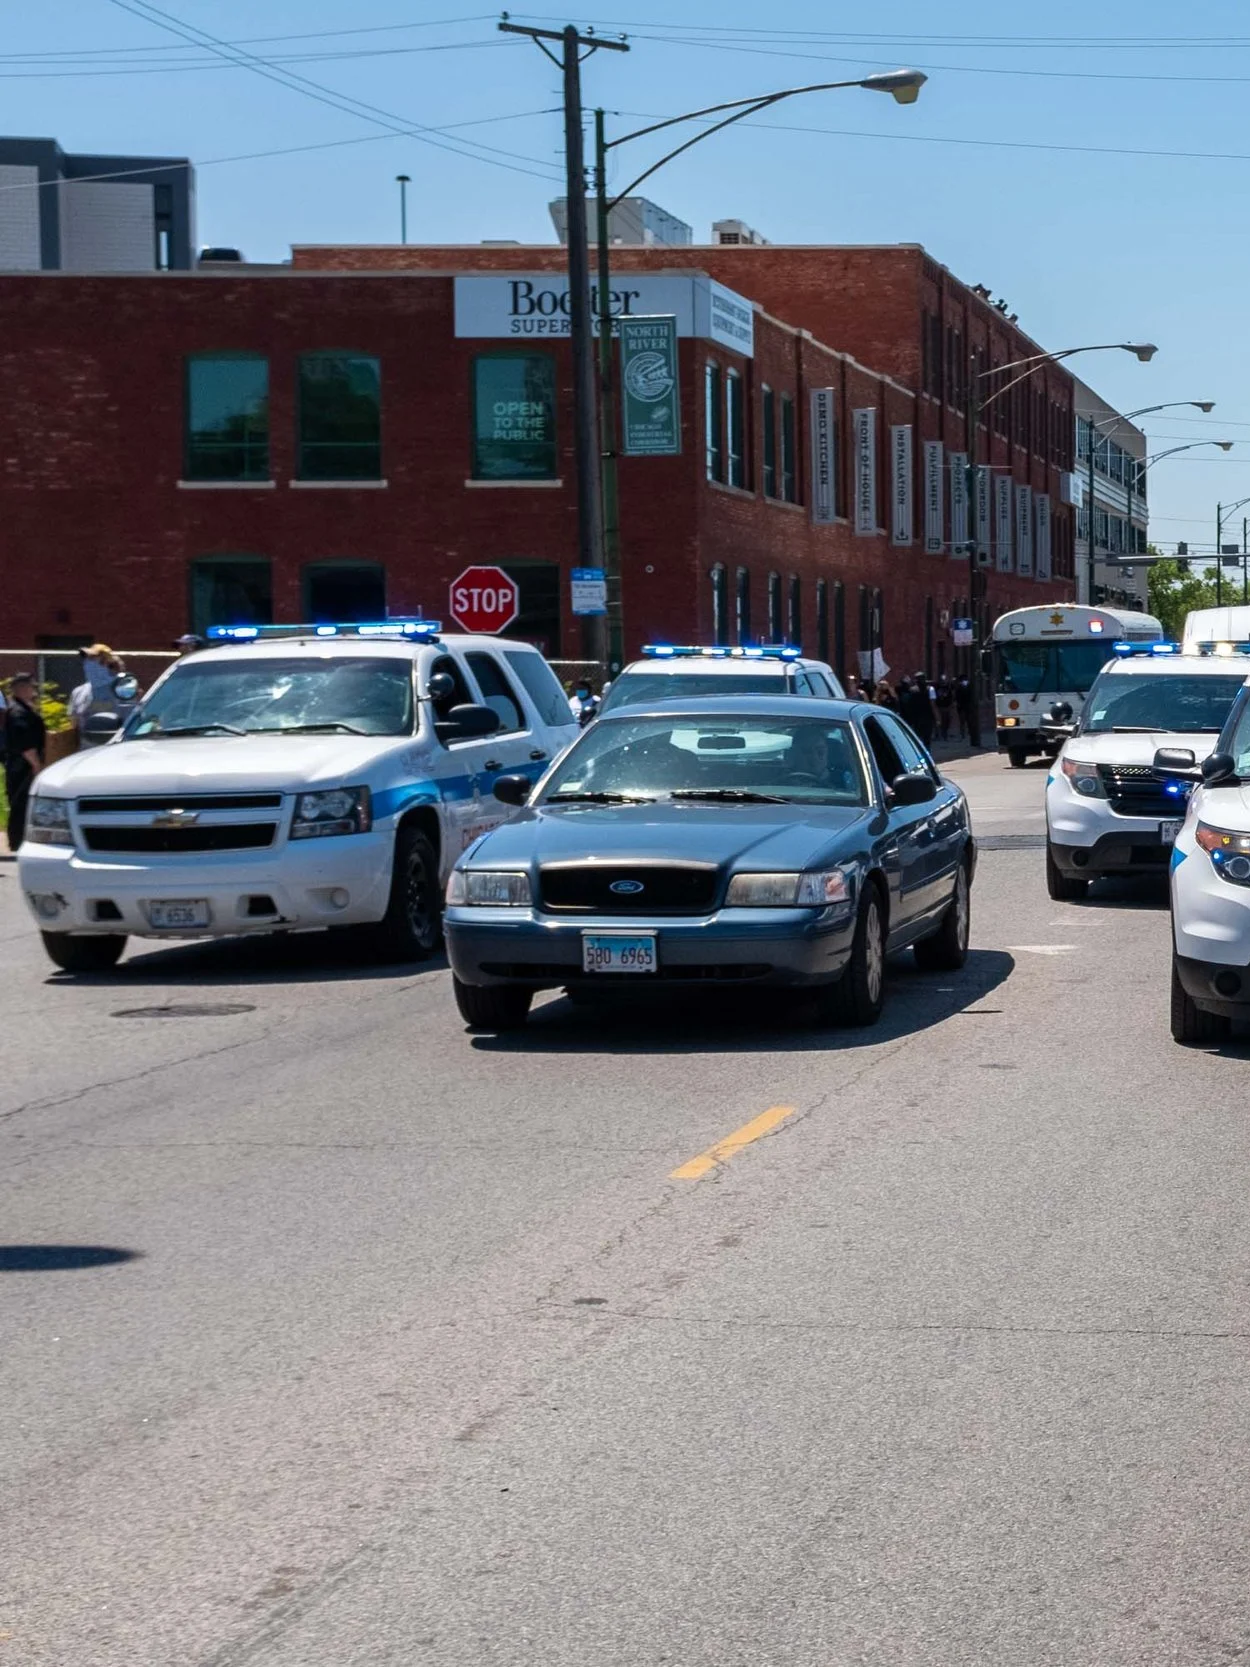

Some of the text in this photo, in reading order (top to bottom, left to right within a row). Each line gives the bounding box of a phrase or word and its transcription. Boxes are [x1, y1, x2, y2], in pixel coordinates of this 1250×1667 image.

[627, 326, 668, 337] NORTH
[629, 338, 667, 349] RIVER
[493, 402, 545, 415] OPEN
[494, 417, 545, 428] TO THE
[493, 429, 545, 440] PUBLIC
[860, 413, 869, 449] FRONT
[817, 393, 829, 485] DEMO KITCHEN
[897, 430, 906, 505] INSTALLATION
[455, 588, 513, 613] STOP
